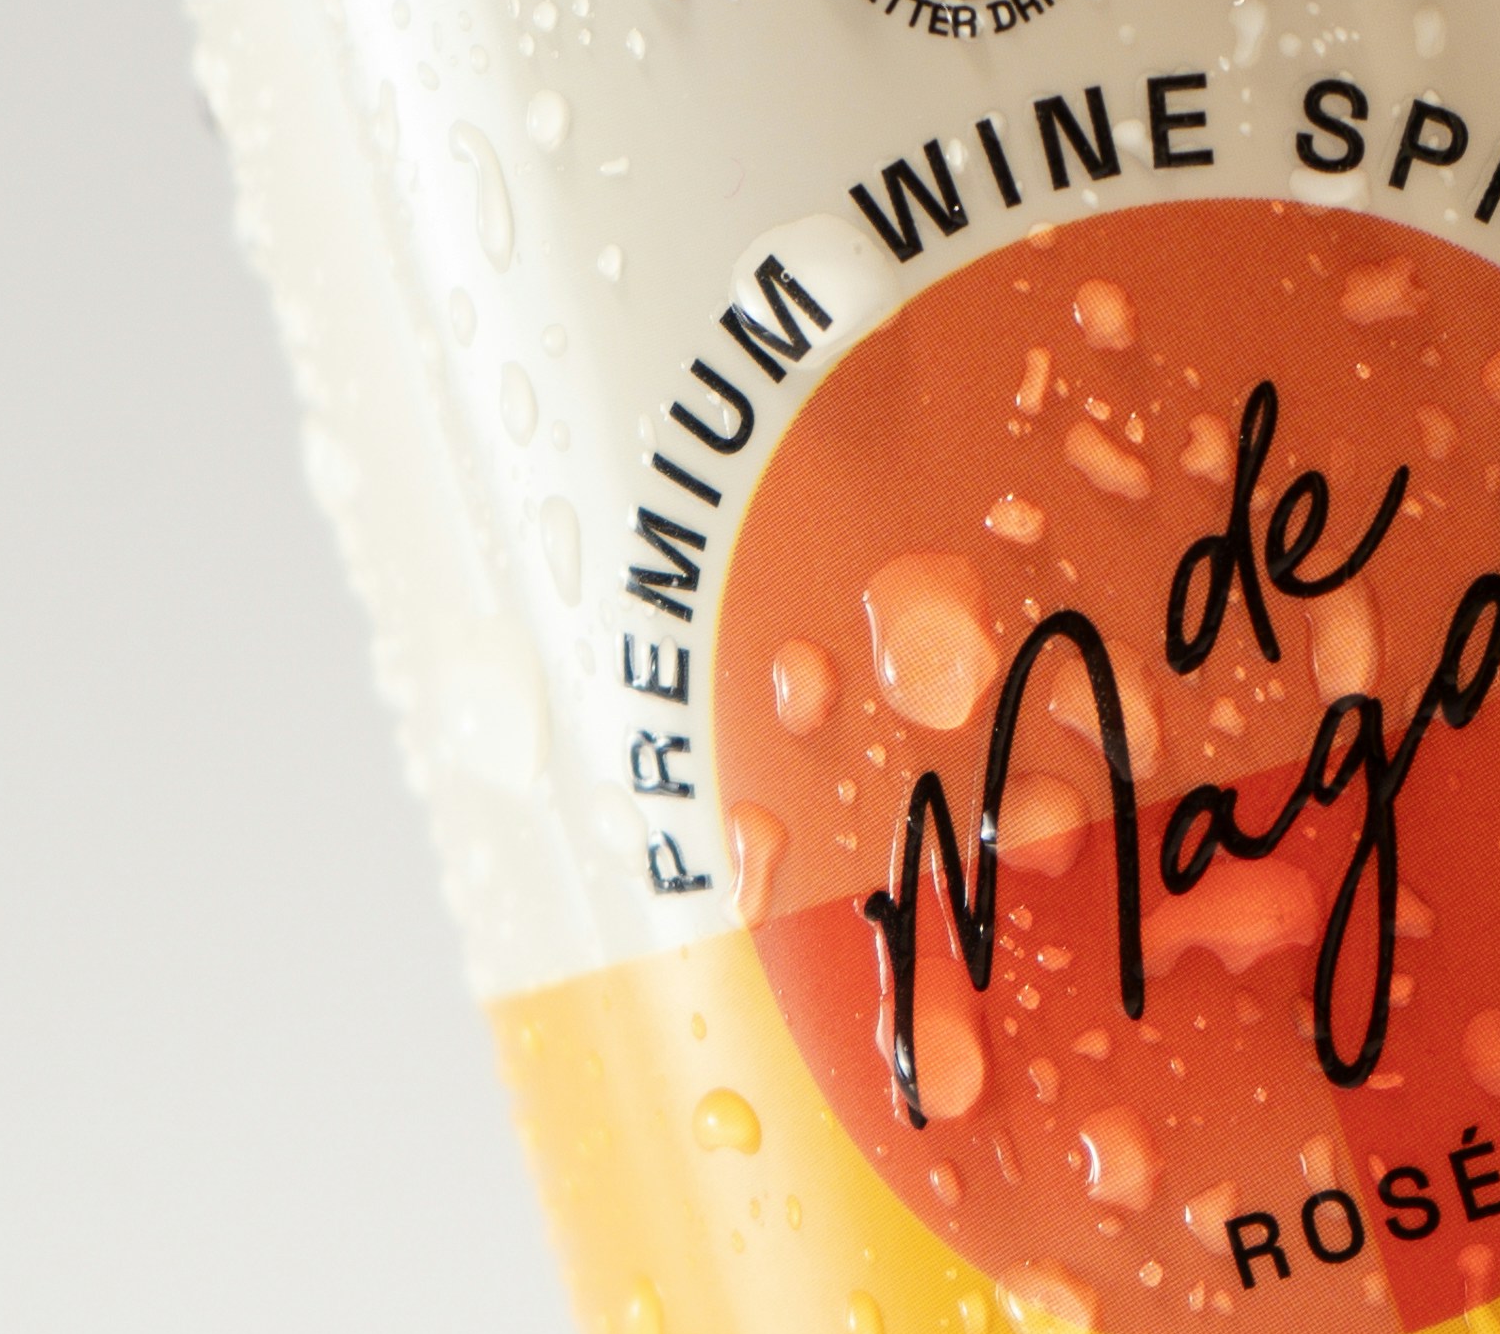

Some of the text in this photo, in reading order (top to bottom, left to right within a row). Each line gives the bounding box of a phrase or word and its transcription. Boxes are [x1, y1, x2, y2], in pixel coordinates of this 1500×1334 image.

[623, 252, 834, 896] PREMIUM
[846, 70, 1216, 264] WINE
[1165, 379, 1411, 676] de
